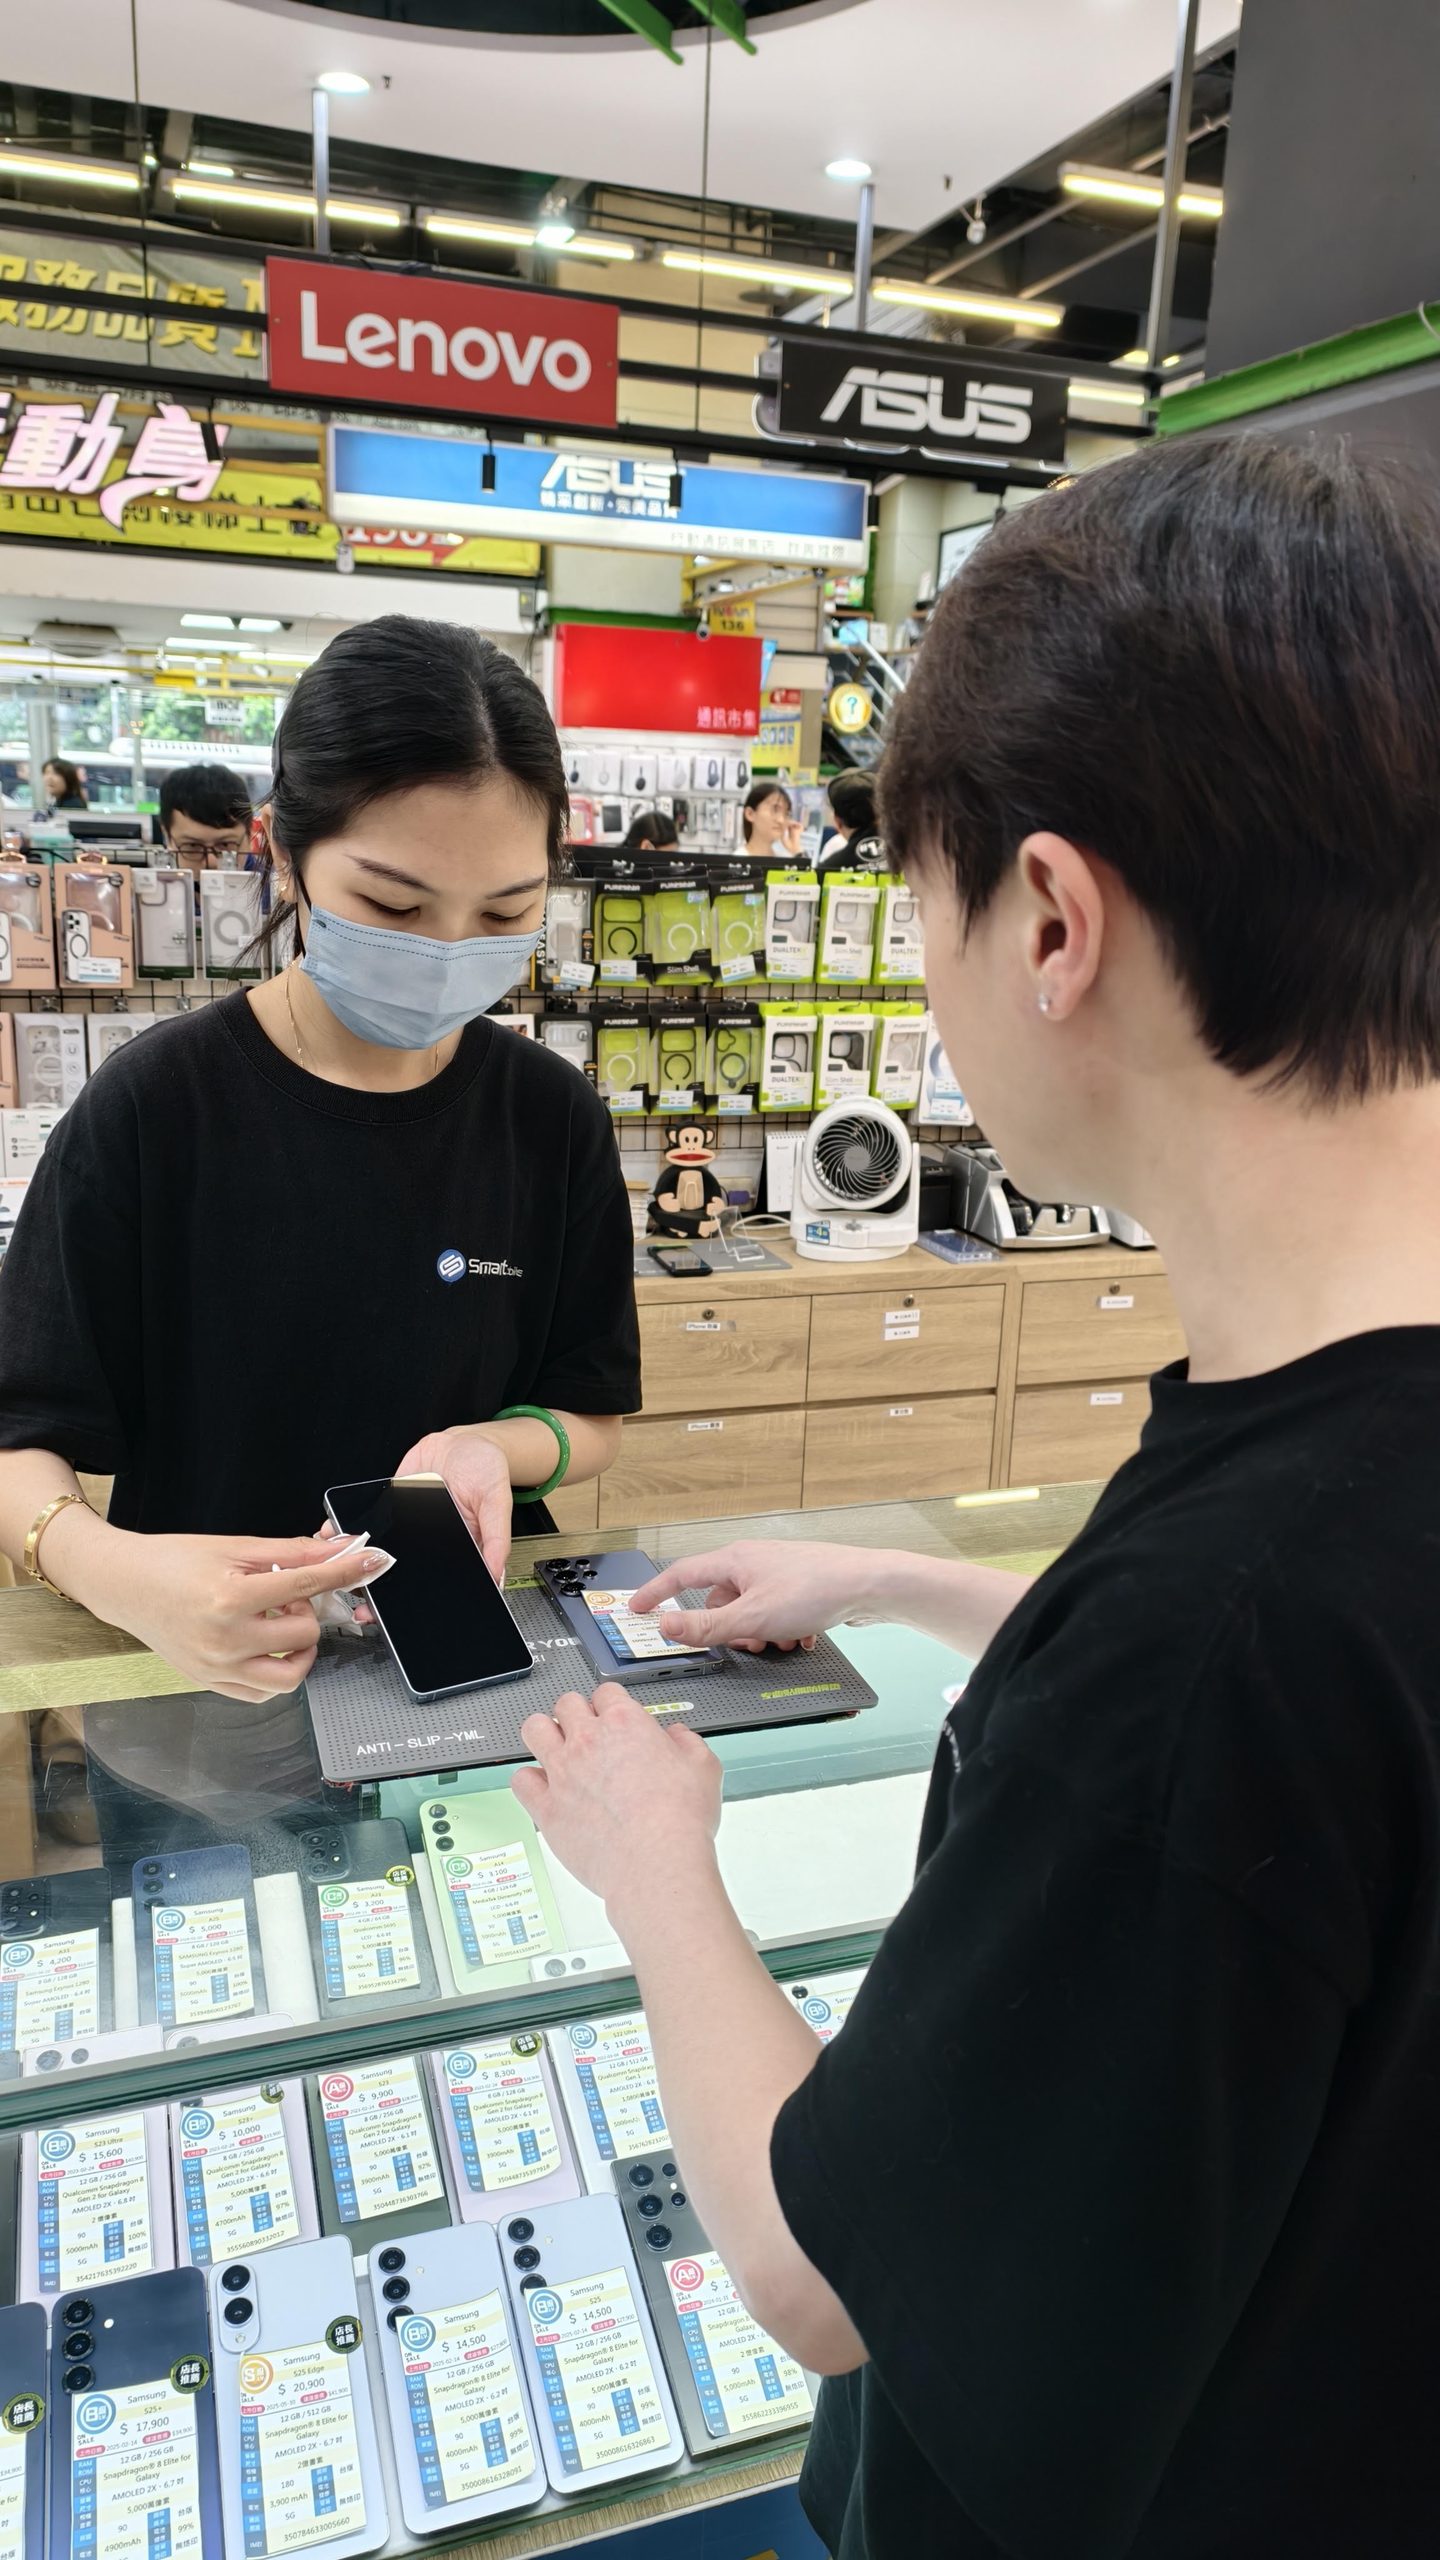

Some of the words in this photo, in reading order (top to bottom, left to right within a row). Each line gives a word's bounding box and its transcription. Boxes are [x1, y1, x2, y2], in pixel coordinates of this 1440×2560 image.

[301, 290, 592, 392] Lenovo
[820, 366, 1033, 444] ASUS
[541, 453, 678, 501] ASUS
[667, 965, 682, 974] Slim
[683, 964, 700, 973] Shell
[356, 1741, 391, 1756] ANTI
[407, 1735, 440, 1749] SLIP
[614, 2037, 640, 2049] 11,000
[360, 2068, 393, 2080] Samsung
[494, 2068, 516, 2079] 8,300
[358, 2093, 365, 2102] $
[371, 2089, 394, 2100] 9,900
[223, 2104, 256, 2117] Samsung
[85, 2126, 120, 2139] Samsung
[218, 2131, 226, 2140] $
[232, 2124, 261, 2138] 10,000
[79, 2152, 86, 2163] $
[93, 2147, 123, 2161] 15,600
[570, 2282, 604, 2296] Samsung
[589, 2296, 601, 2305] S25
[444, 2309, 479, 2325] Samsung
[569, 2313, 577, 2324] $
[583, 2306, 612, 2321] 14,500
[335, 2324, 353, 2336] 店長
[463, 2324, 476, 2333] S25
[336, 2334, 355, 2347] 推薦
[441, 2341, 450, 2353] $
[456, 2334, 486, 2350] 14,500
[584, 2338, 595, 2347] GB
[599, 2334, 612, 2344] 256
[612, 2332, 622, 2341] GB
[629, 2338, 639, 2348] for
[283, 2353, 321, 2366] Samsung
[592, 2355, 615, 2367] Galaxy
[180, 2362, 201, 2375] 店長
[293, 2369, 306, 2378] S25
[307, 2365, 325, 2375] Edge
[180, 2372, 201, 2385] 推薦
[576, 2369, 604, 2383] AMOLED
[278, 2384, 286, 2395] $
[293, 2378, 325, 2393] 20,900
[127, 2390, 166, 2404] Samsung
[13, 2400, 34, 2415] 店長
[144, 2405, 163, 2415] S25+
[281, 2415, 288, 2423] 12
[289, 2411, 301, 2421] GB
[306, 2407, 319, 2417] 512
[319, 2405, 331, 2415] GB
[13, 2410, 35, 2425] 推薦
[321, 2416, 337, 2427] Elite
[337, 2413, 348, 2423] for
[579, 2414, 611, 2428] 4000mAh
[120, 2423, 128, 2436] $
[136, 2416, 169, 2432] 17,900
[78, 2436, 95, 2446] SALE
[296, 2430, 320, 2441] Galaxy
[593, 2431, 604, 2440] 5G
[120, 2456, 129, 2465] 12
[129, 2452, 142, 2462] GB
[148, 2447, 162, 2457] 256
[163, 2445, 174, 2454] GB
[274, 2445, 306, 2459] AMOLED
[308, 2442, 318, 2451] 2X
[163, 2456, 179, 2467] Elite
[180, 2453, 191, 2464] for
[135, 2471, 160, 2483] Galaxy
[281, 2480, 294, 2489] 180
[112, 2487, 146, 2501] AMOLED
[146, 2484, 157, 2493] 2X
[269, 2497, 290, 2509] 3,900
[290, 2492, 308, 2503] mAh
[285, 2512, 296, 2521] 5G
[178, 2522, 195, 2533] 99%
[104, 2537, 142, 2553] 4900mAh
